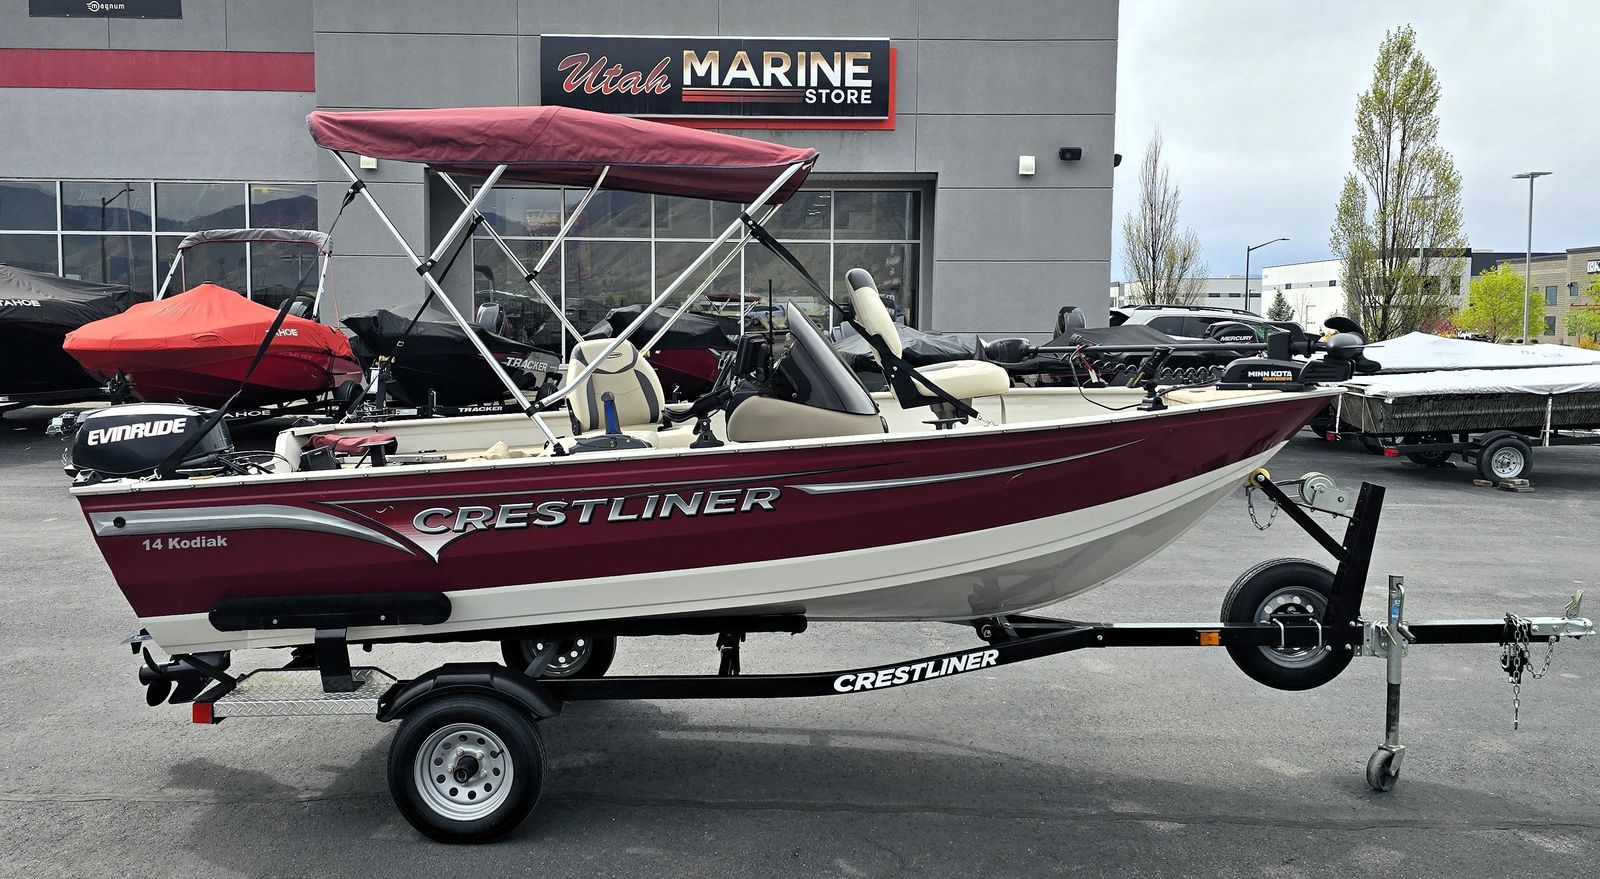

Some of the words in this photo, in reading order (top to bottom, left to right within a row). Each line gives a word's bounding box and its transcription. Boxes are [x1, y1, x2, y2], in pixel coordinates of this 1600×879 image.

[557, 52, 671, 95] Utah
[682, 50, 872, 87] MARINE
[805, 88, 872, 104] STORE
[506, 356, 548, 371] TRACKER
[222, 409, 271, 419] AHOE
[458, 405, 503, 413] TRACKER
[87, 417, 187, 446] EVINRUDE
[411, 486, 782, 535] CRESTLINER
[142, 538, 163, 551] 14
[168, 535, 228, 550] Kodiak
[833, 649, 999, 692] CRESTLINER
